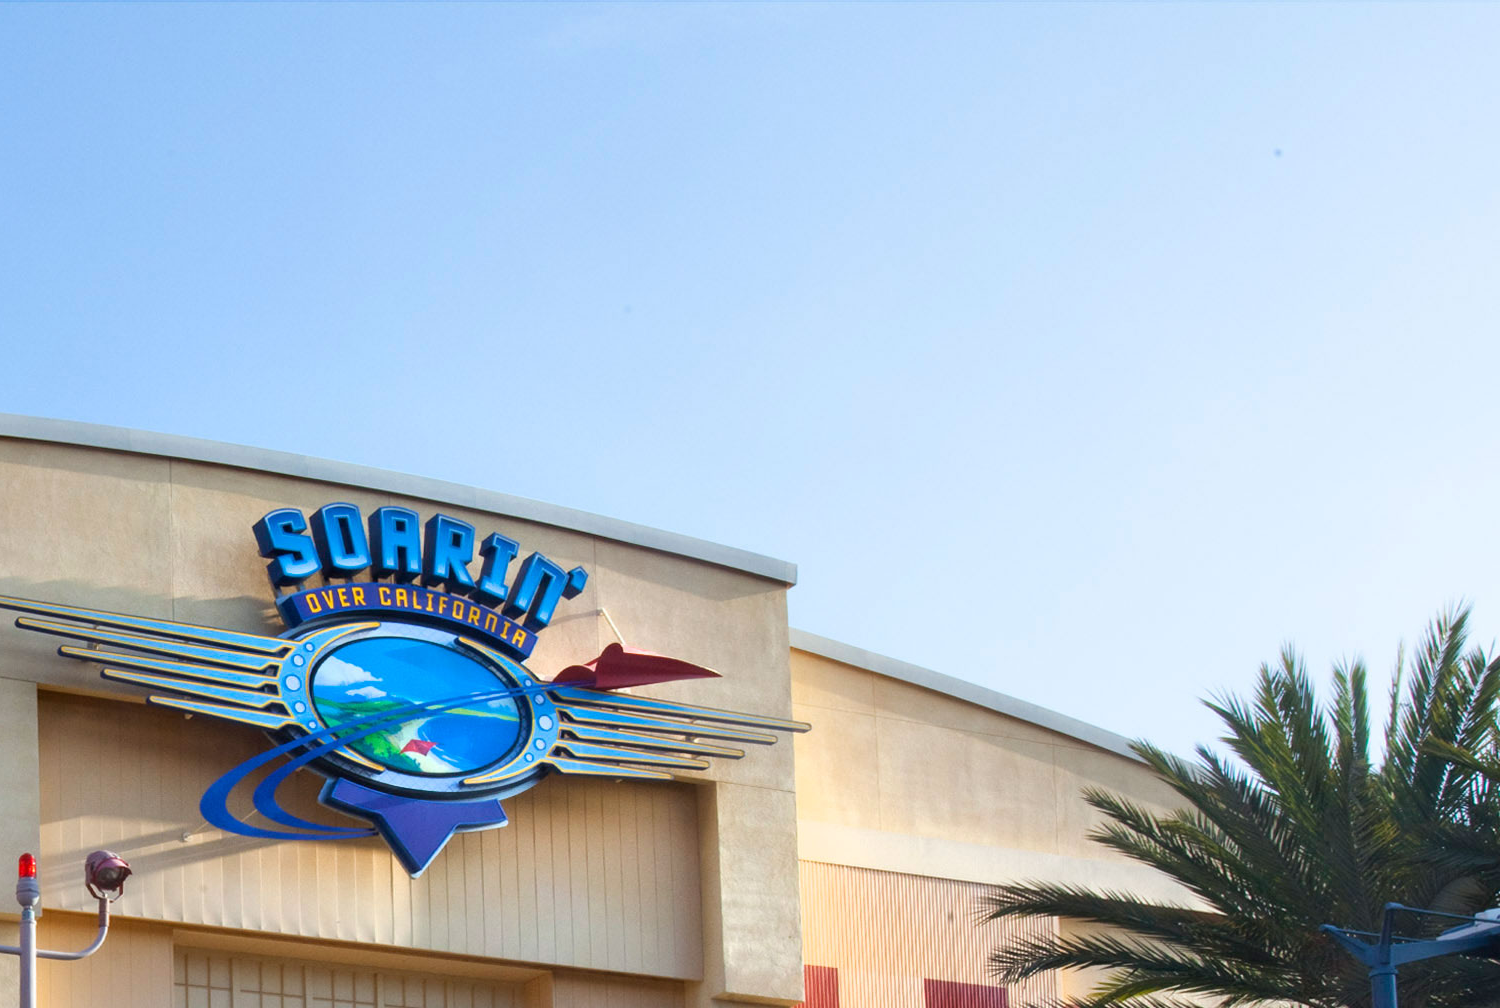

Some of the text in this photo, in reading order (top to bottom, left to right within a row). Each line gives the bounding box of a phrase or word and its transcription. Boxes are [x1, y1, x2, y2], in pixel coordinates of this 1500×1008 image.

[253, 502, 589, 633] SOARIN'
[305, 586, 528, 648] OVER CALIFORNIA
